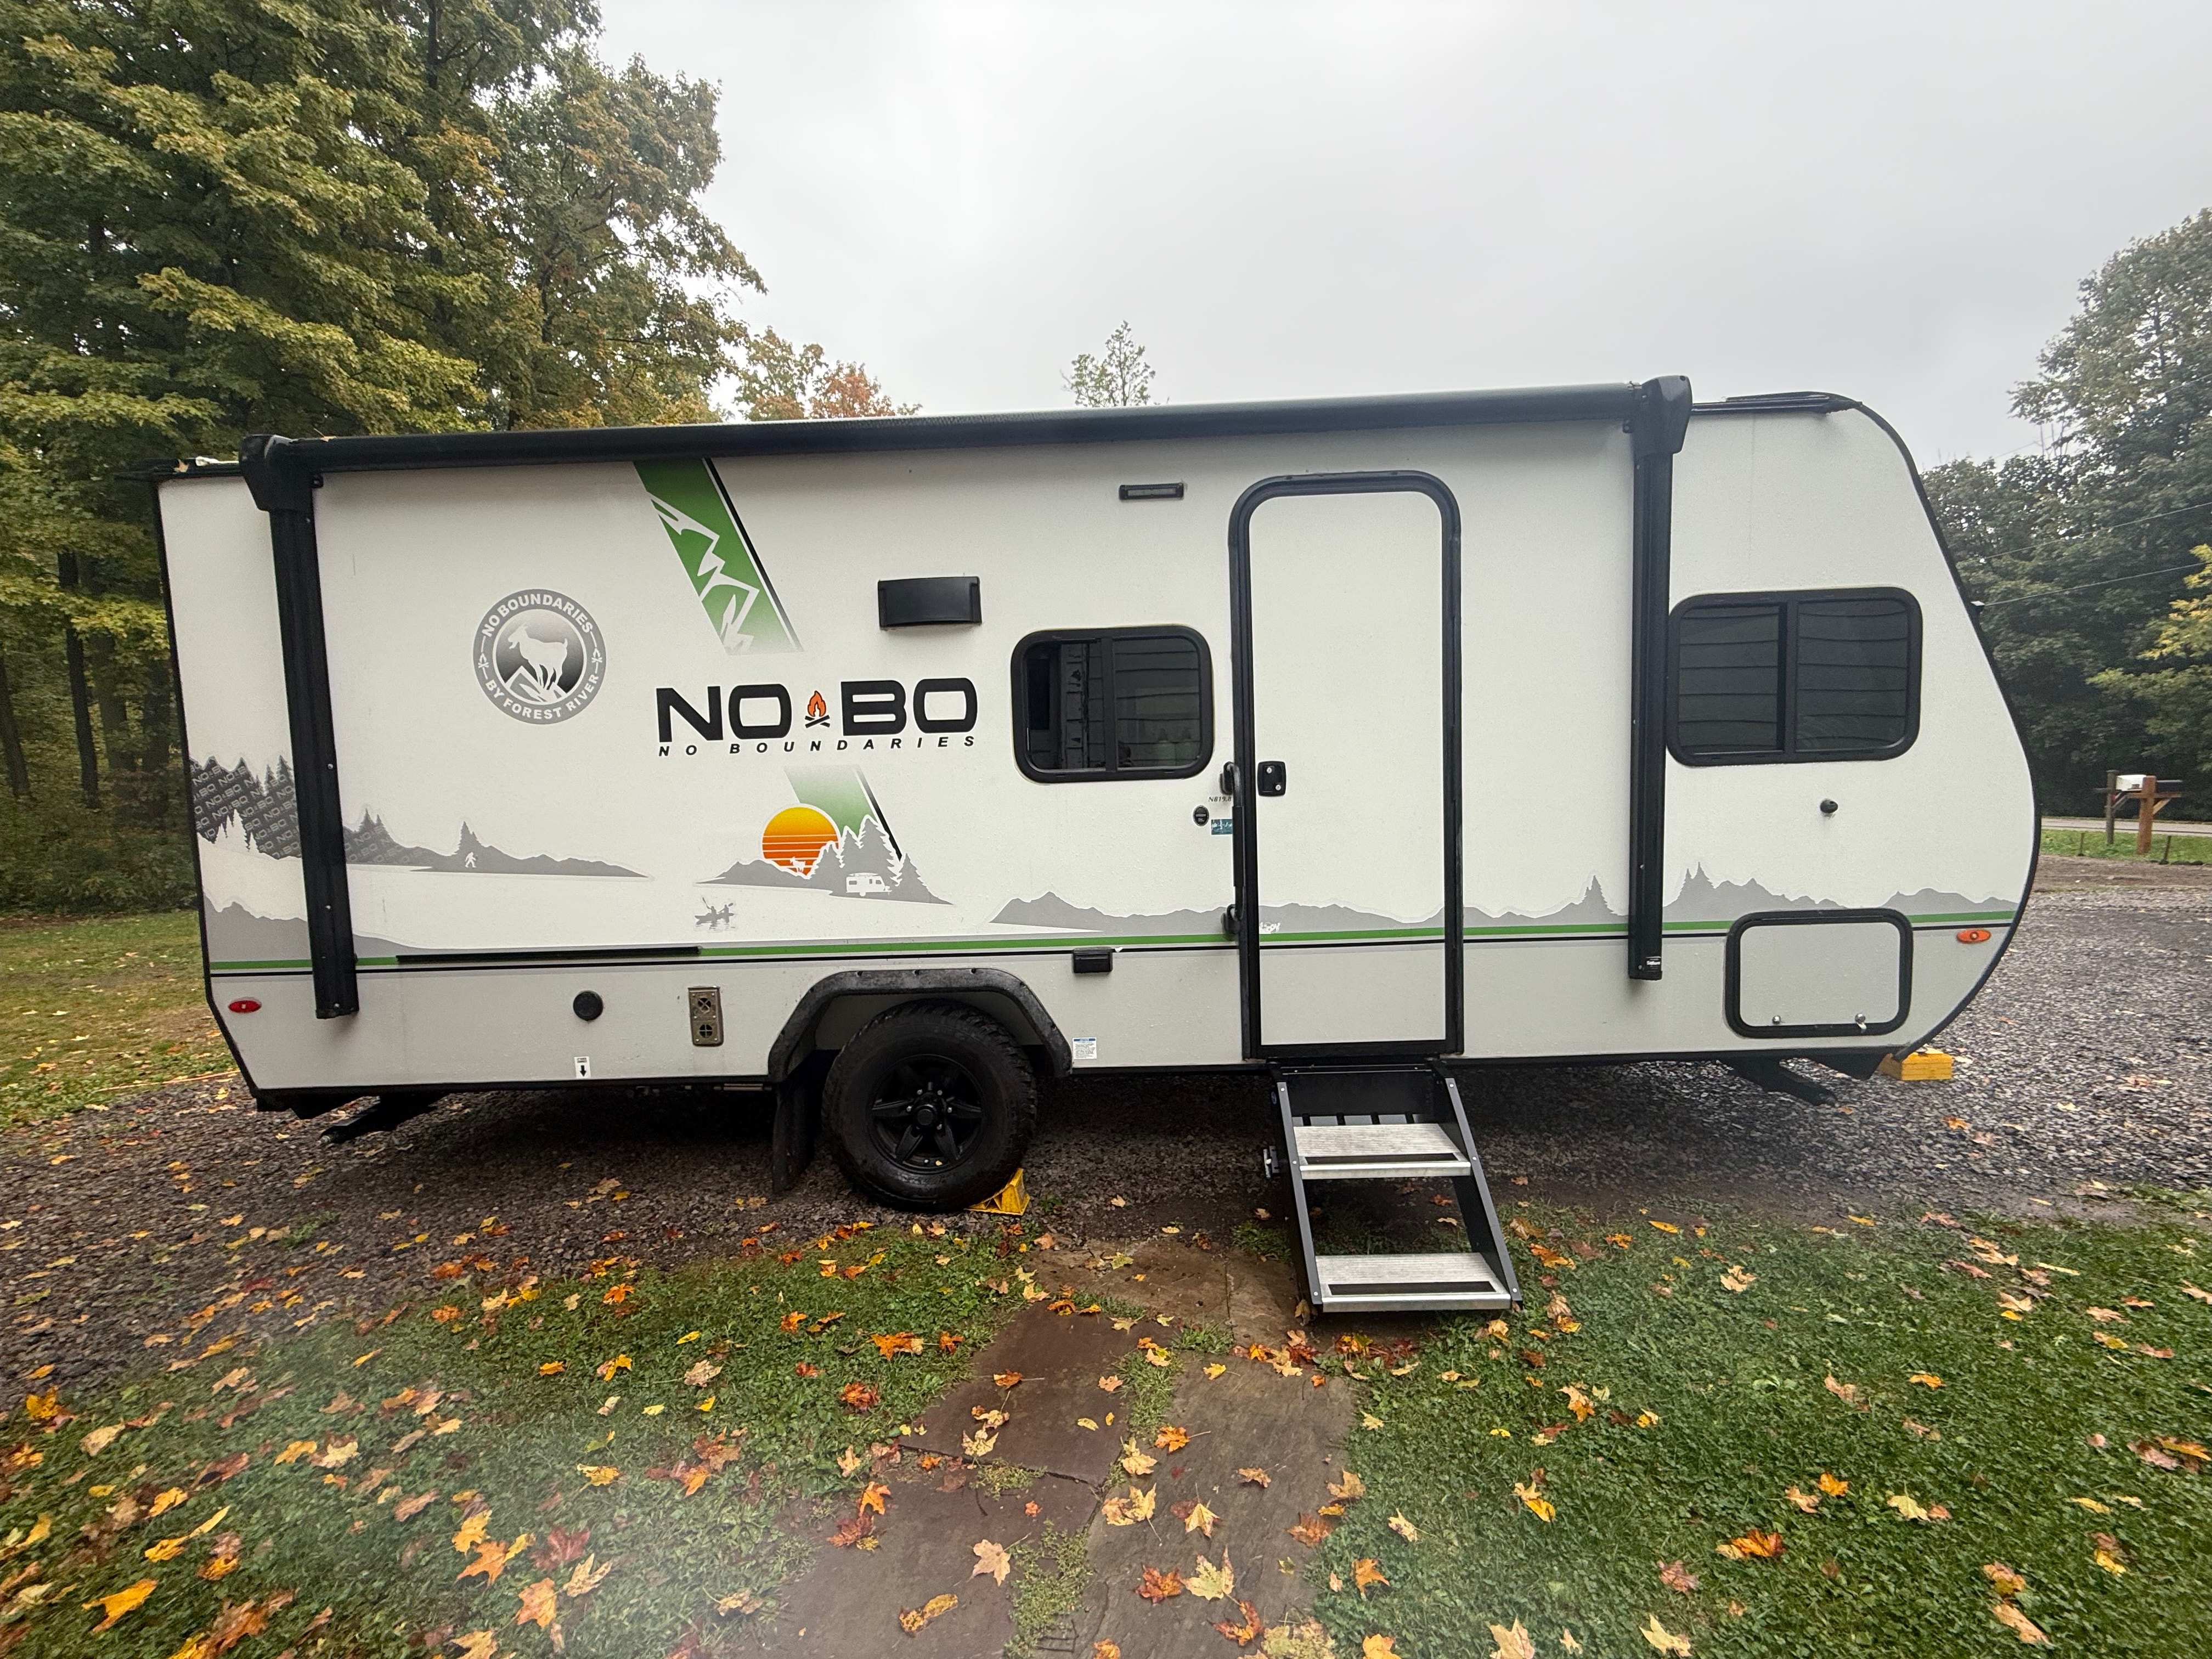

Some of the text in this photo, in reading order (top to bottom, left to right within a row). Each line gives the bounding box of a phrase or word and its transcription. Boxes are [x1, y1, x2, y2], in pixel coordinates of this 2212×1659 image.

[482, 593, 593, 637] NO BOUNDARIES
[486, 674, 599, 720] BY FOREST RIVER
[658, 736, 974, 757] NO BOUNDARIES
